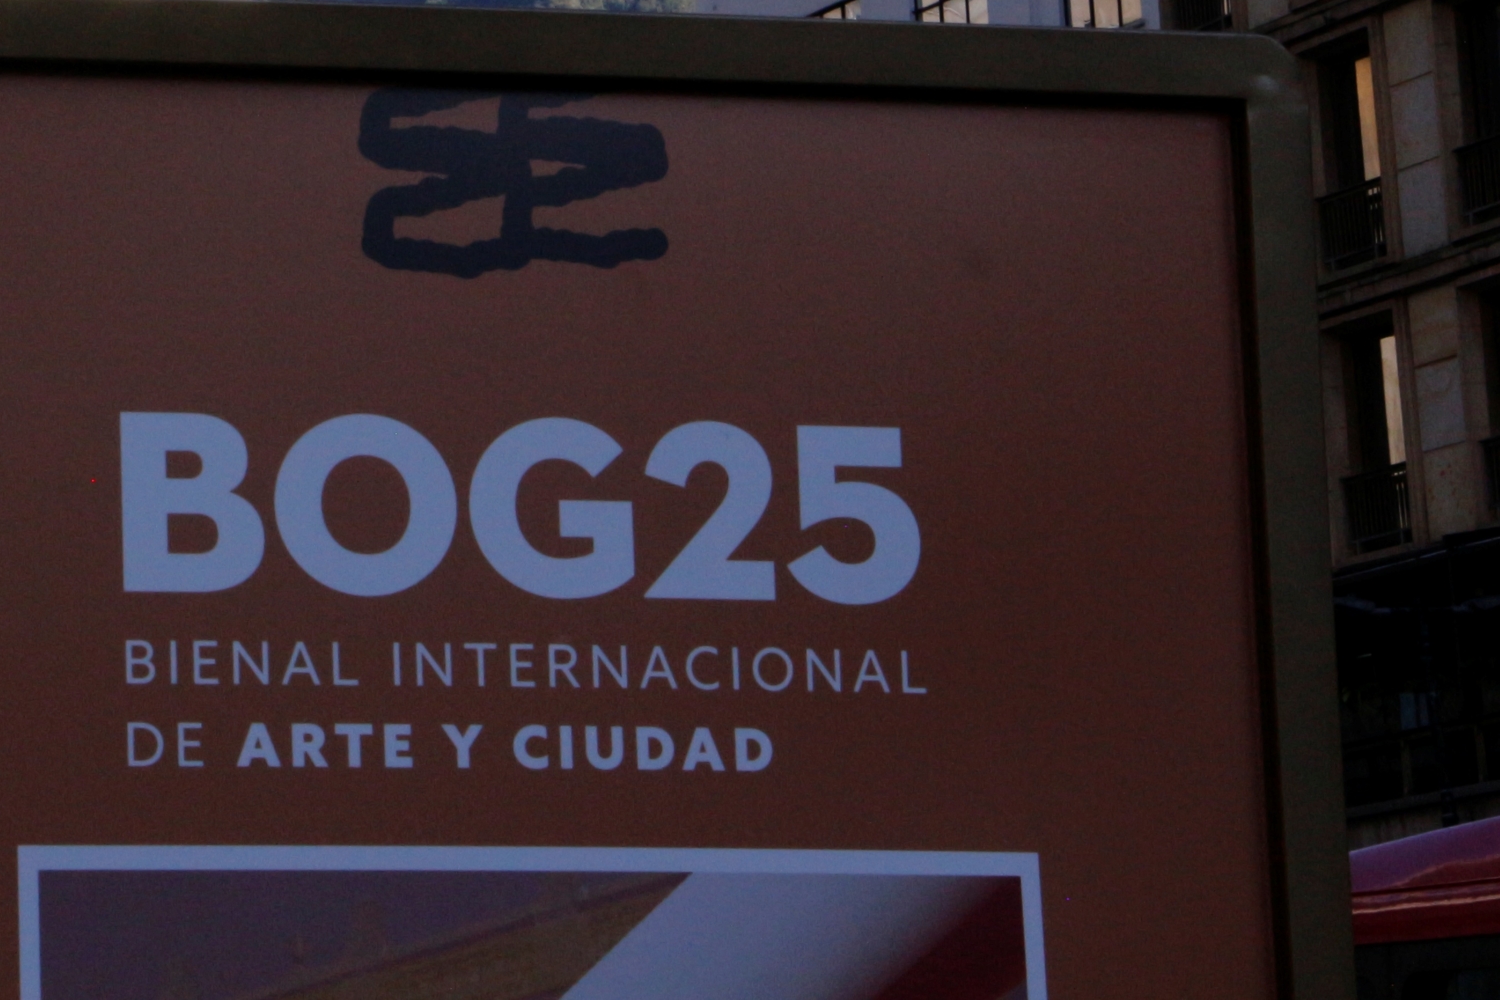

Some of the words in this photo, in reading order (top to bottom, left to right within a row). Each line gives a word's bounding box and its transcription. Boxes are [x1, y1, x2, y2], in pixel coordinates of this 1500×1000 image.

[119, 411, 921, 605] BOG25
[125, 640, 359, 686] BIENAL
[393, 642, 927, 694] INTERNACIONAL
[127, 722, 204, 767] DE
[237, 723, 413, 768] ARTE
[442, 724, 483, 769] Y
[513, 724, 773, 772] CIUDAD
